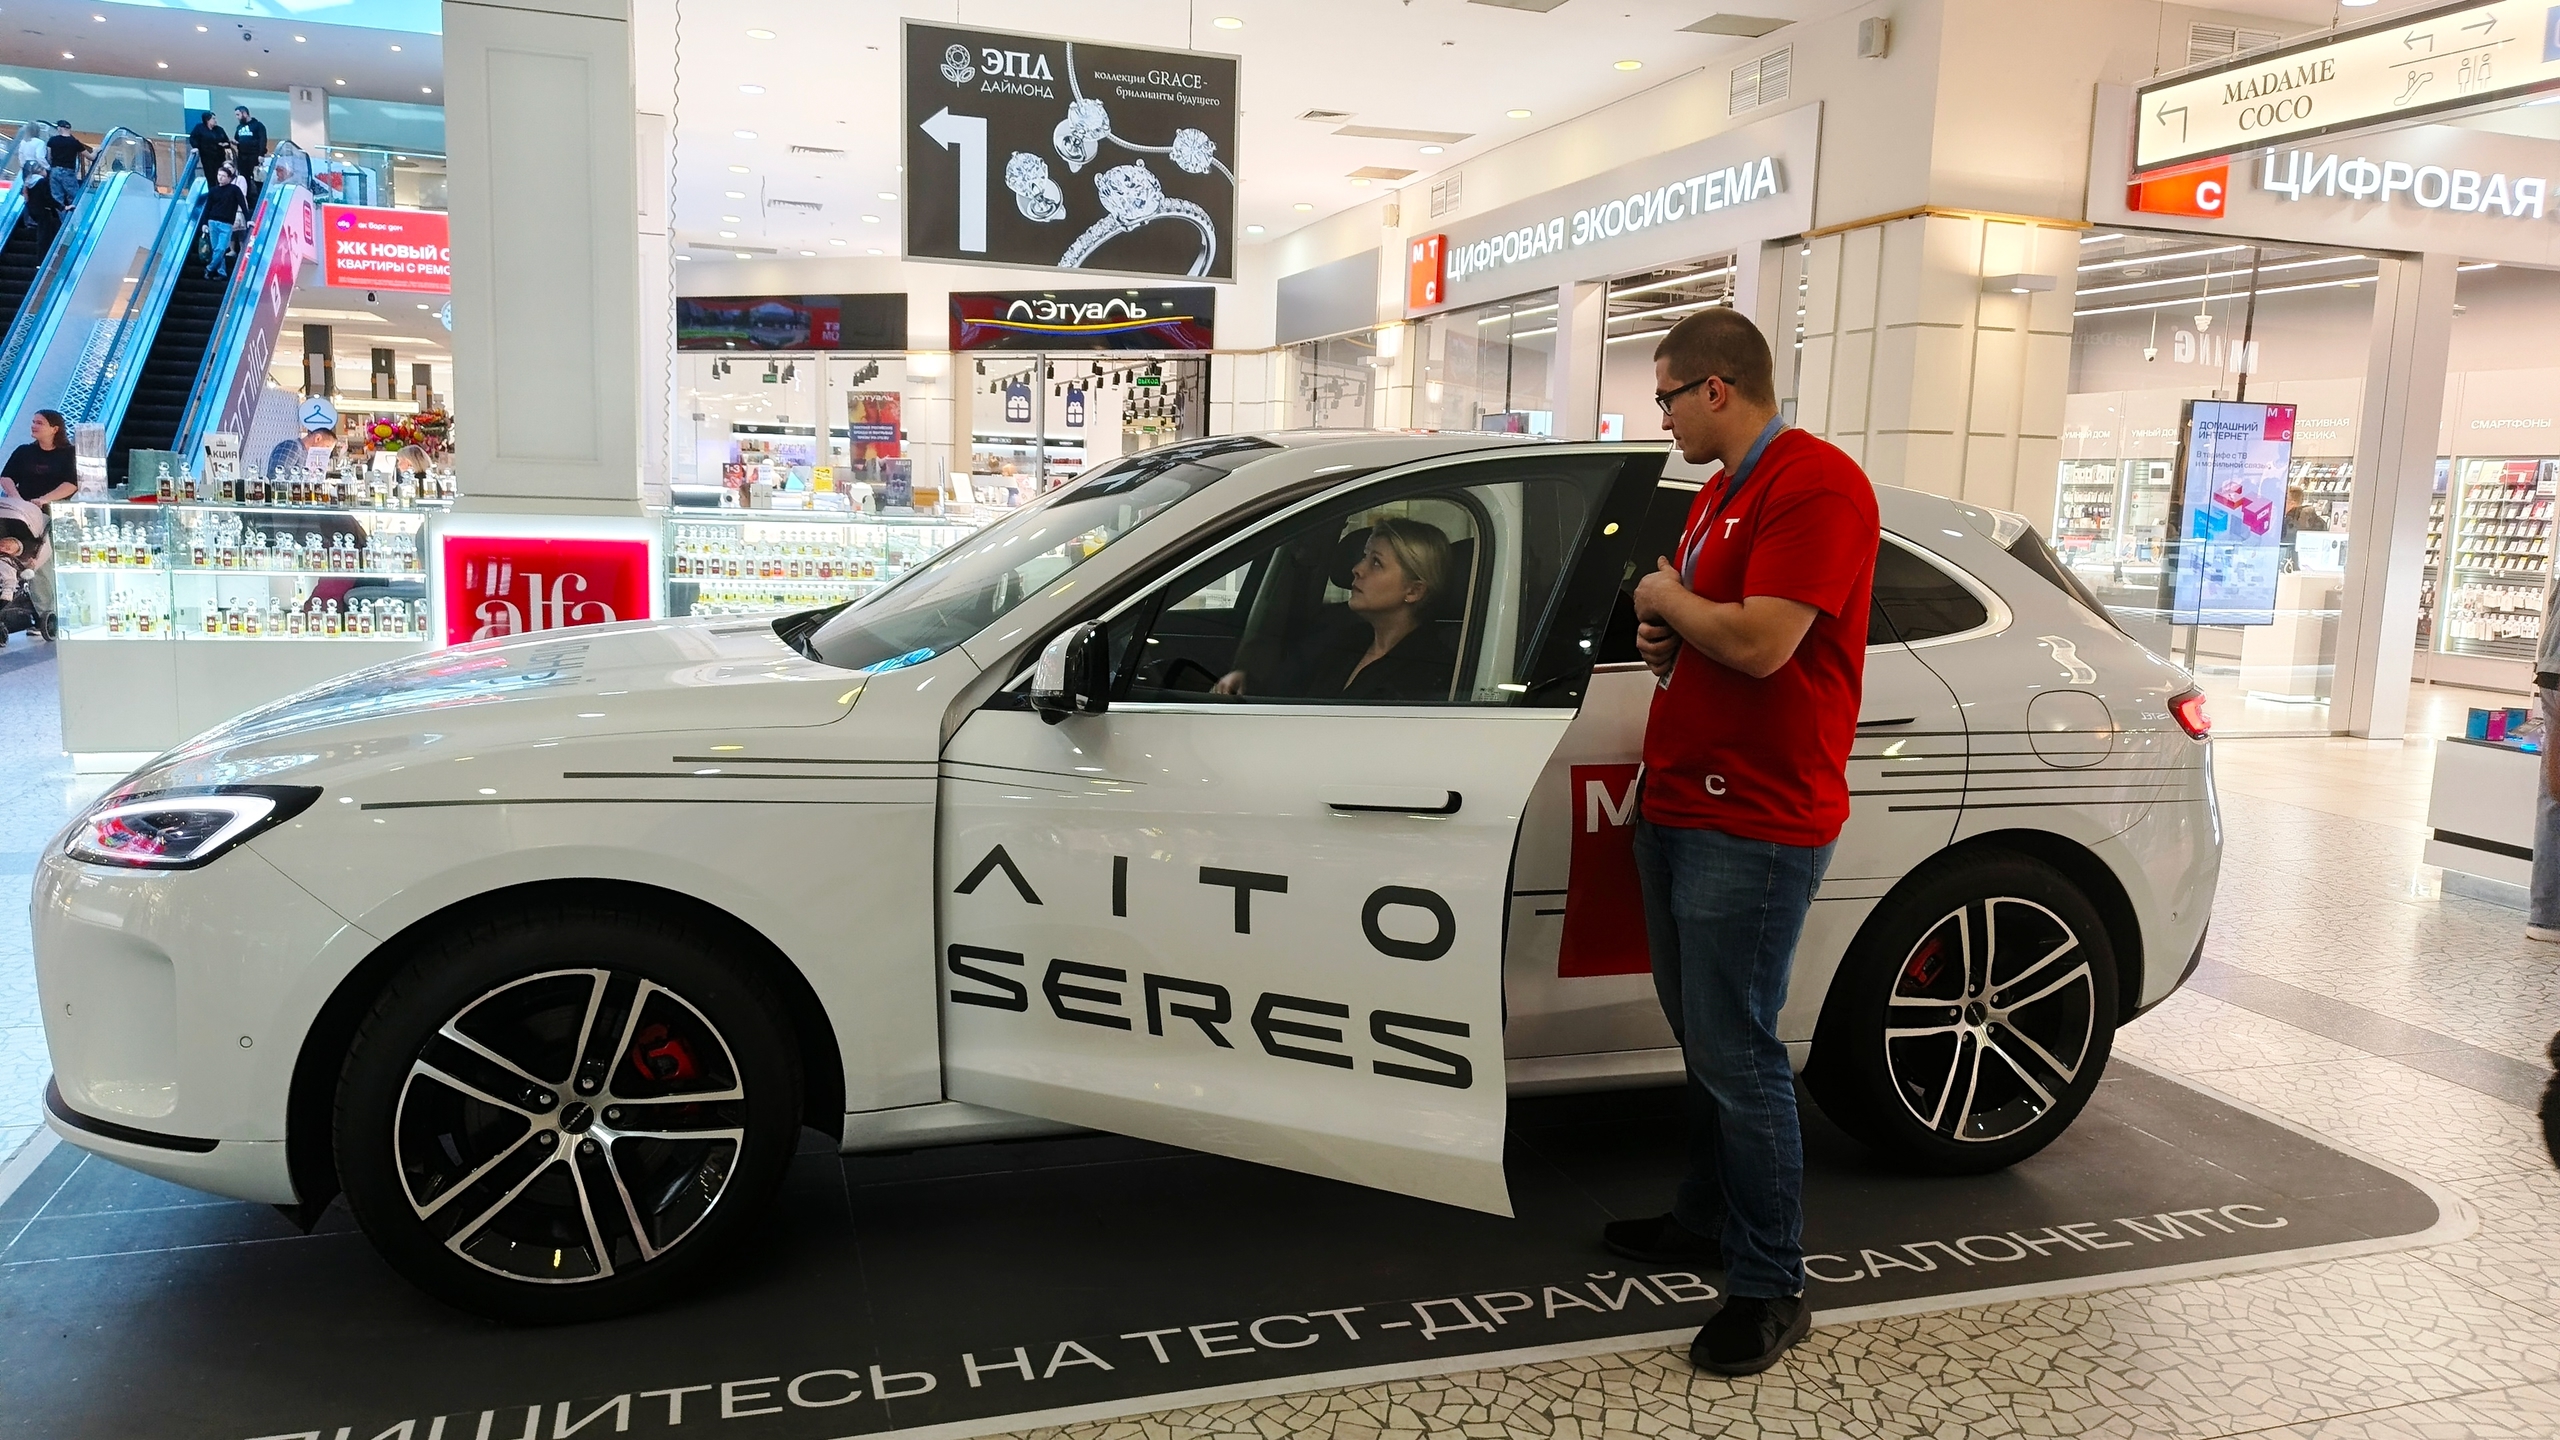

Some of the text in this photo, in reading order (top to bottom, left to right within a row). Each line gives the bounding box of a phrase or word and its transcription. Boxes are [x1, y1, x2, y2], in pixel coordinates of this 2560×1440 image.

[981, 48, 1054, 81] ЭПЛ
[1094, 70, 1146, 85] коллекция
[2221, 58, 2335, 106] MADAME
[980, 79, 1054, 99] ДАЙМОНД
[1116, 85, 1221, 107] бриллианты будущего
[2238, 95, 2314, 131] COCO
[2263, 147, 2548, 220] ЦИФРОВАЯ
[1447, 156, 1778, 282] ЦИФРОВАЯ ЭКОСИСТЕМА
[337, 240, 368, 255] ЖК
[371, 242, 438, 261] НОВЫЙ
[337, 258, 404, 273] КВАРТИРЫ
[2131, 427, 2161, 437] УМНЫЙ
[2199, 421, 2258, 432] ДОМАШНИЙ
[2295, 417, 2350, 428] РТАТИВНАЯ
[2470, 418, 2552, 429] СМАРТФОНЫ
[2065, 430, 2111, 440] УМНЫЙ ДОМ
[2198, 431, 2249, 441] ИНТЕРНЕТ
[947, 943, 1473, 1090] SERES
[961, 1340, 1114, 1388] НА
[1120, 1270, 1719, 1365] ТЕСТ-ДРАЙВ
[1800, 1221, 2134, 1284] САЛОНЕ
[2114, 1203, 2290, 1243] МТС
